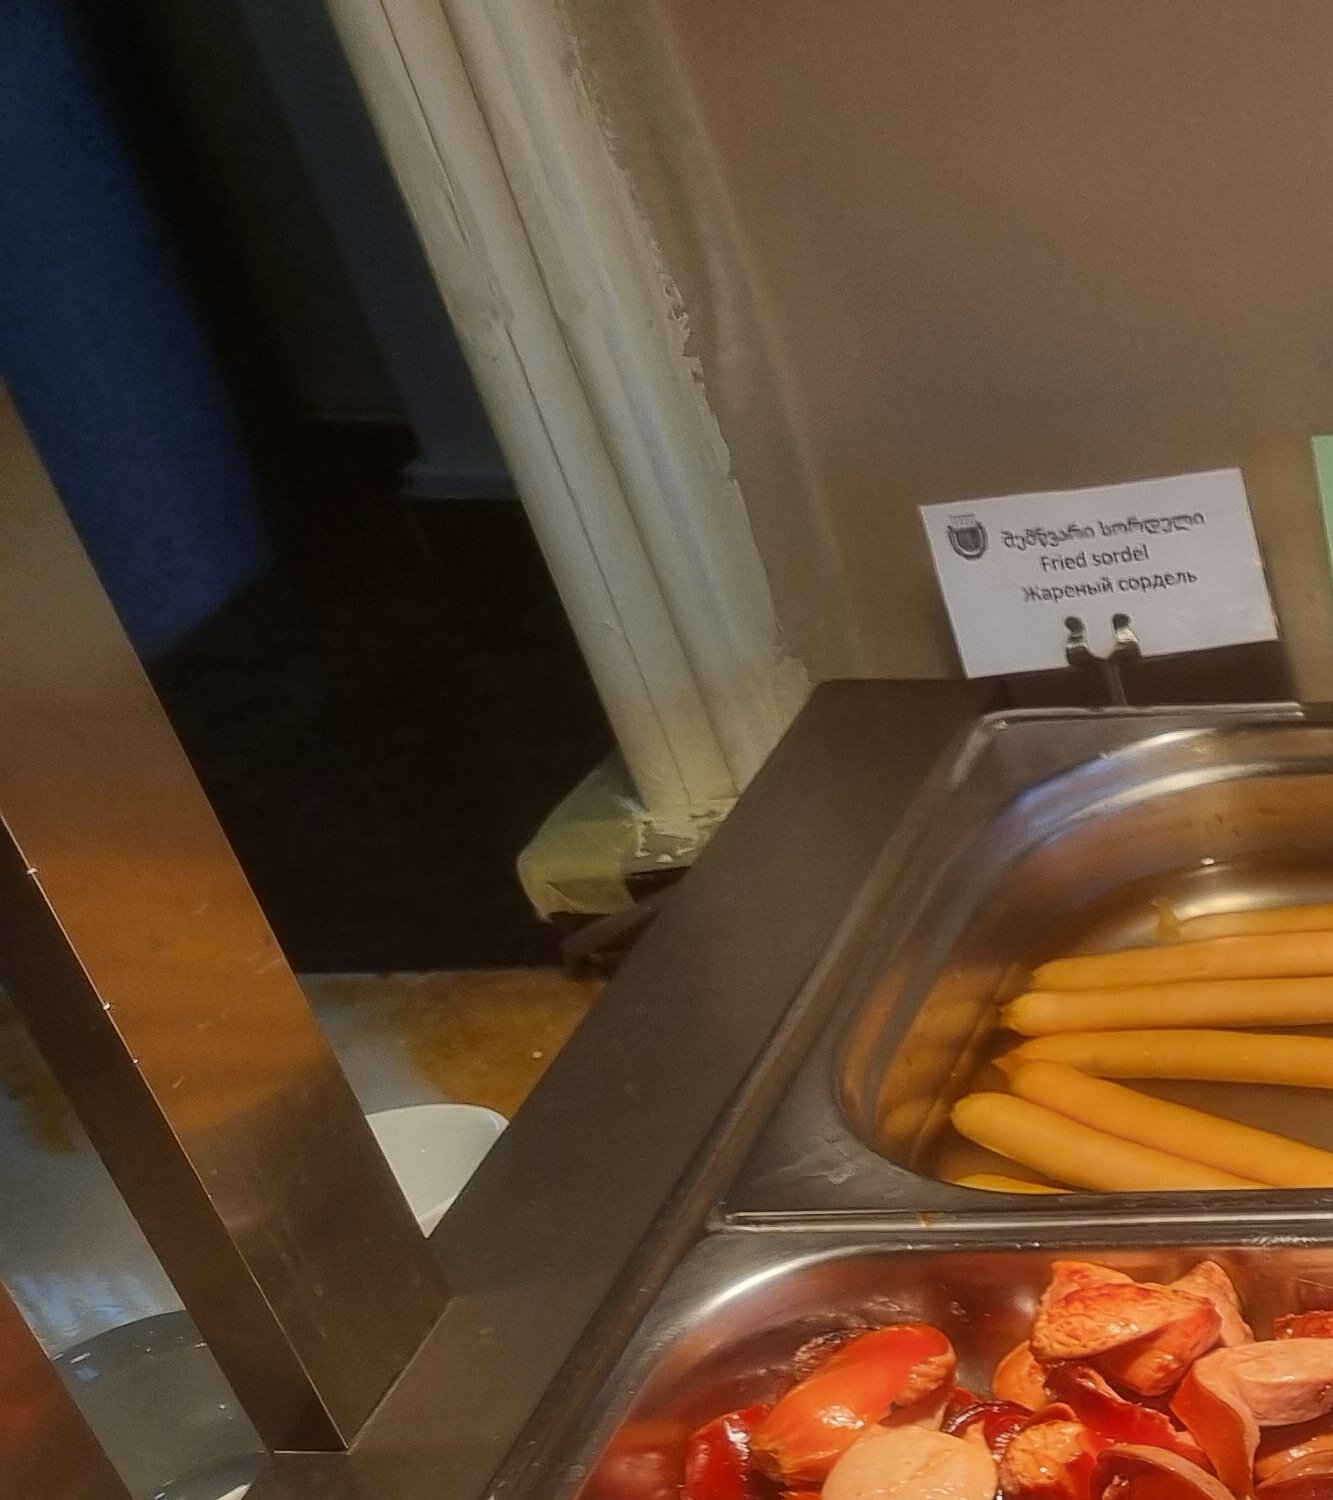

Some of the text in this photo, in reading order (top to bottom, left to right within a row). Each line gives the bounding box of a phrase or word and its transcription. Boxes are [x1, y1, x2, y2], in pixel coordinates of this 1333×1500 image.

[1041, 544, 1150, 572] Fried sordel
[1023, 570, 1198, 603] Жареный сордель
